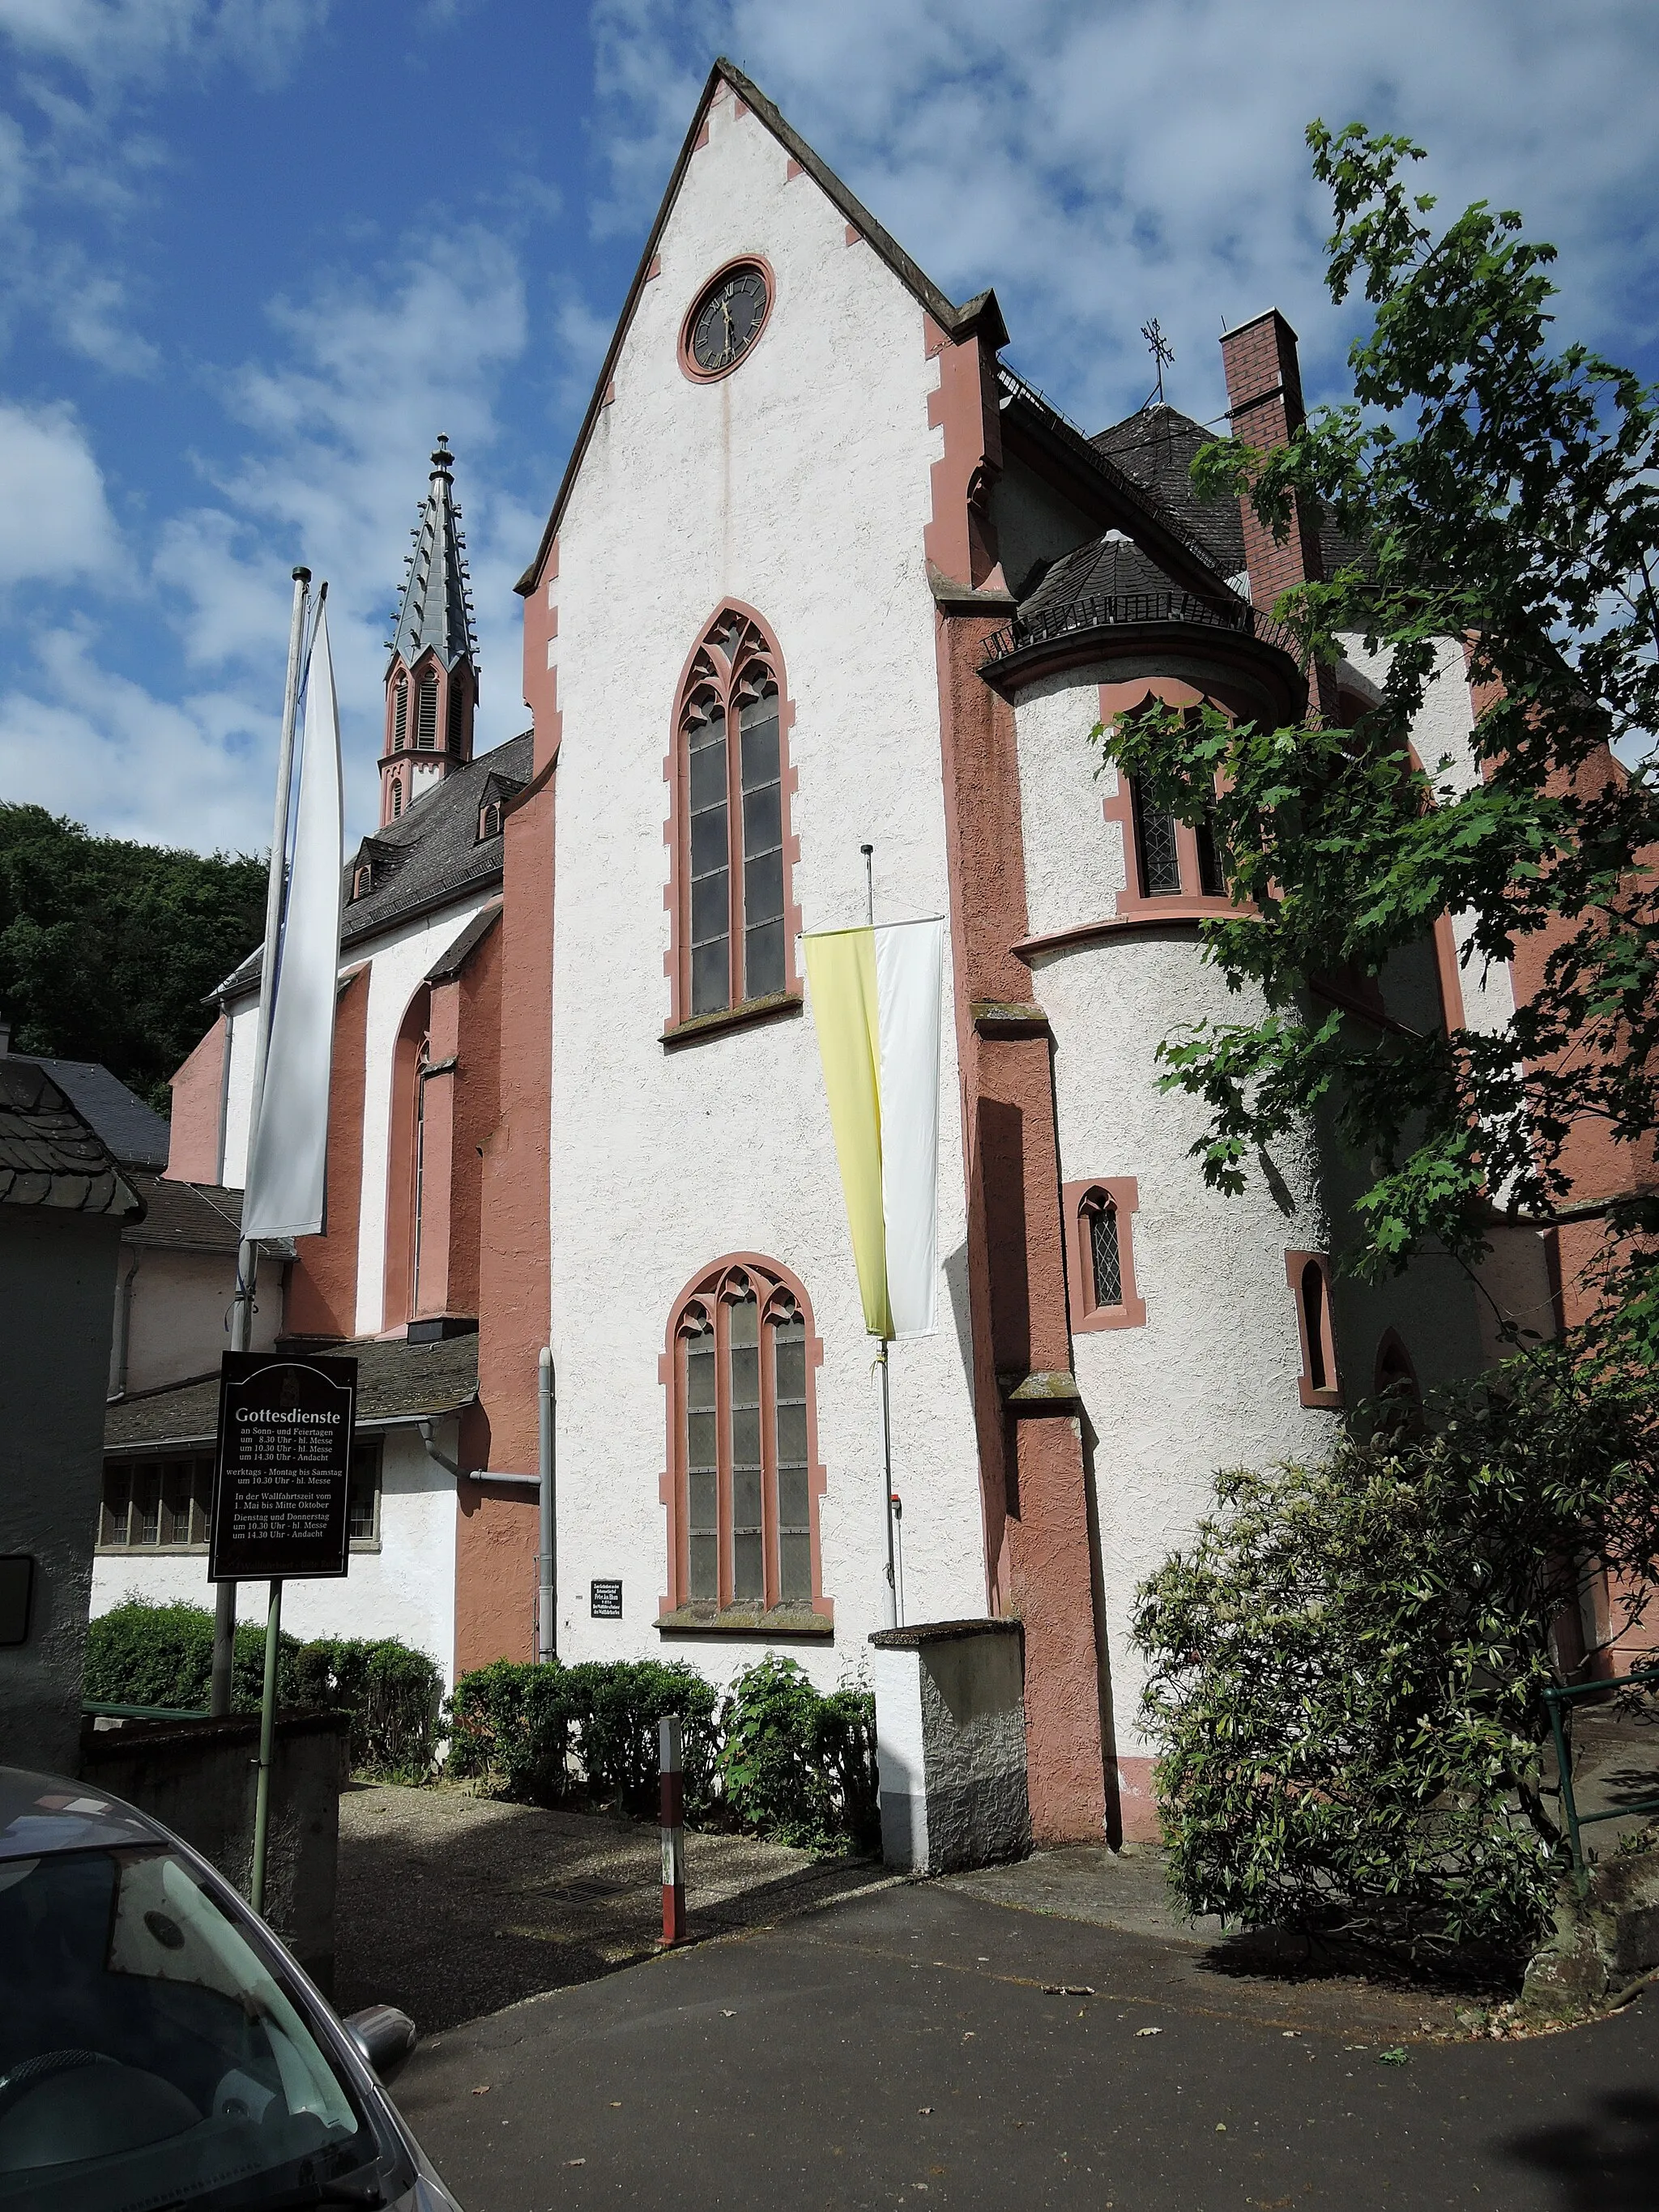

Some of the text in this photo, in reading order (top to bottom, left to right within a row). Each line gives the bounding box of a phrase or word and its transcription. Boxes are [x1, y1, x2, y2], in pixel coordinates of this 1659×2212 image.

[236, 1408, 340, 1424] Gottesdienste
[293, 1428, 333, 1437] Feiertagen
[312, 1468, 343, 1477] Samstag
[261, 1492, 313, 1500] Wallfahrtszeit
[233, 1514, 268, 1522] Dienstag
